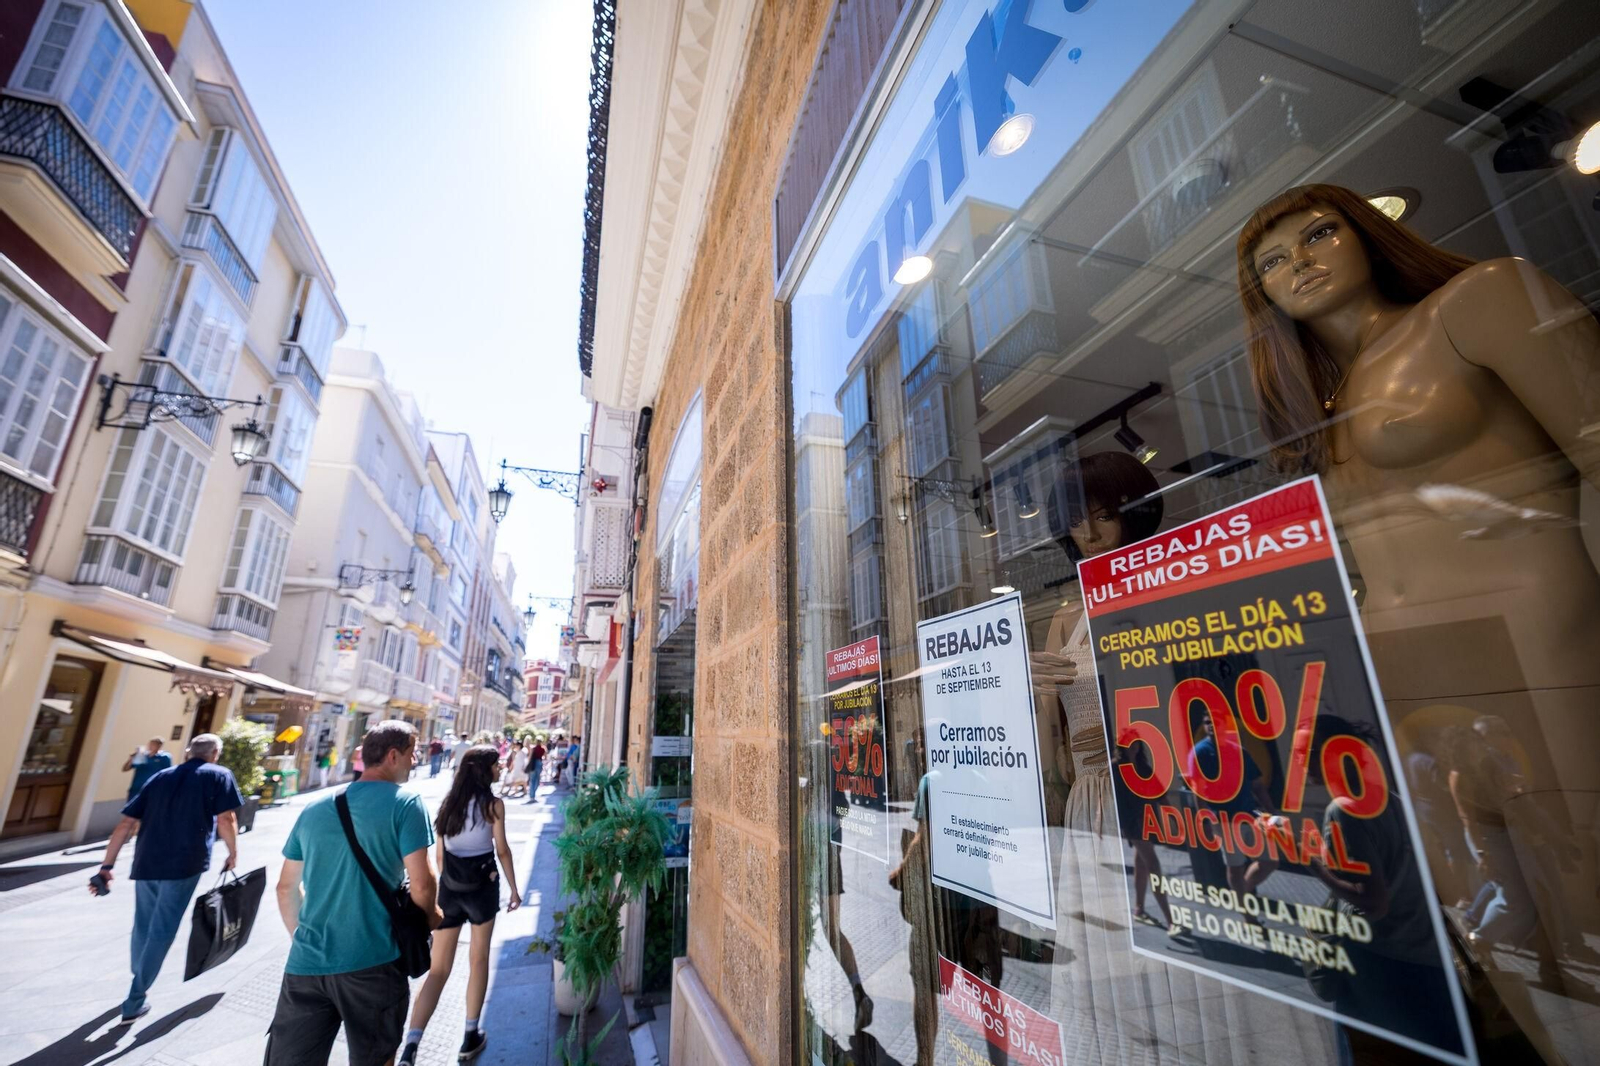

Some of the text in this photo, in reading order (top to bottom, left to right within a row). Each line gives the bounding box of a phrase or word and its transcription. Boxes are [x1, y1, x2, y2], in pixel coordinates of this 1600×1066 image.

[846, 0, 1088, 339] anik
[1087, 519, 1324, 610] ¡ULTIMOS DÍAS!
[1110, 513, 1252, 576] REBAJAS
[925, 617, 1013, 662] REBAJAS
[1099, 590, 1327, 654] CERRAMOS EL DÍA 13
[833, 644, 866, 663] REBAJAS
[857, 653, 879, 669] DÍAS!
[1119, 621, 1305, 671] POR JUBILACIÓN
[936, 675, 1002, 695] DE SEPTIEMBRE
[941, 661, 992, 681] HASTA EL 13
[834, 700, 844, 710] POR
[832, 714, 883, 777] 50%
[939, 722, 1007, 742] Cerramos
[1114, 660, 1389, 819] 50%
[931, 745, 1029, 770] por jubilación
[835, 776, 878, 799] ADICIONAL
[943, 826, 1018, 853] cerrará definitivamente
[951, 814, 1010, 837] El establecimiento
[1142, 803, 1372, 876] ADICIONAL
[956, 842, 1004, 864] por jubilación
[1150, 872, 1373, 944] PAGUE SOLO LA MITAD
[1169, 903, 1357, 976] DE LO QUE MARCA
[941, 984, 1005, 1038] ¡ULTIMOS
[952, 971, 1027, 1030] REBAJAS
[946, 1028, 996, 1066] CERRAM
